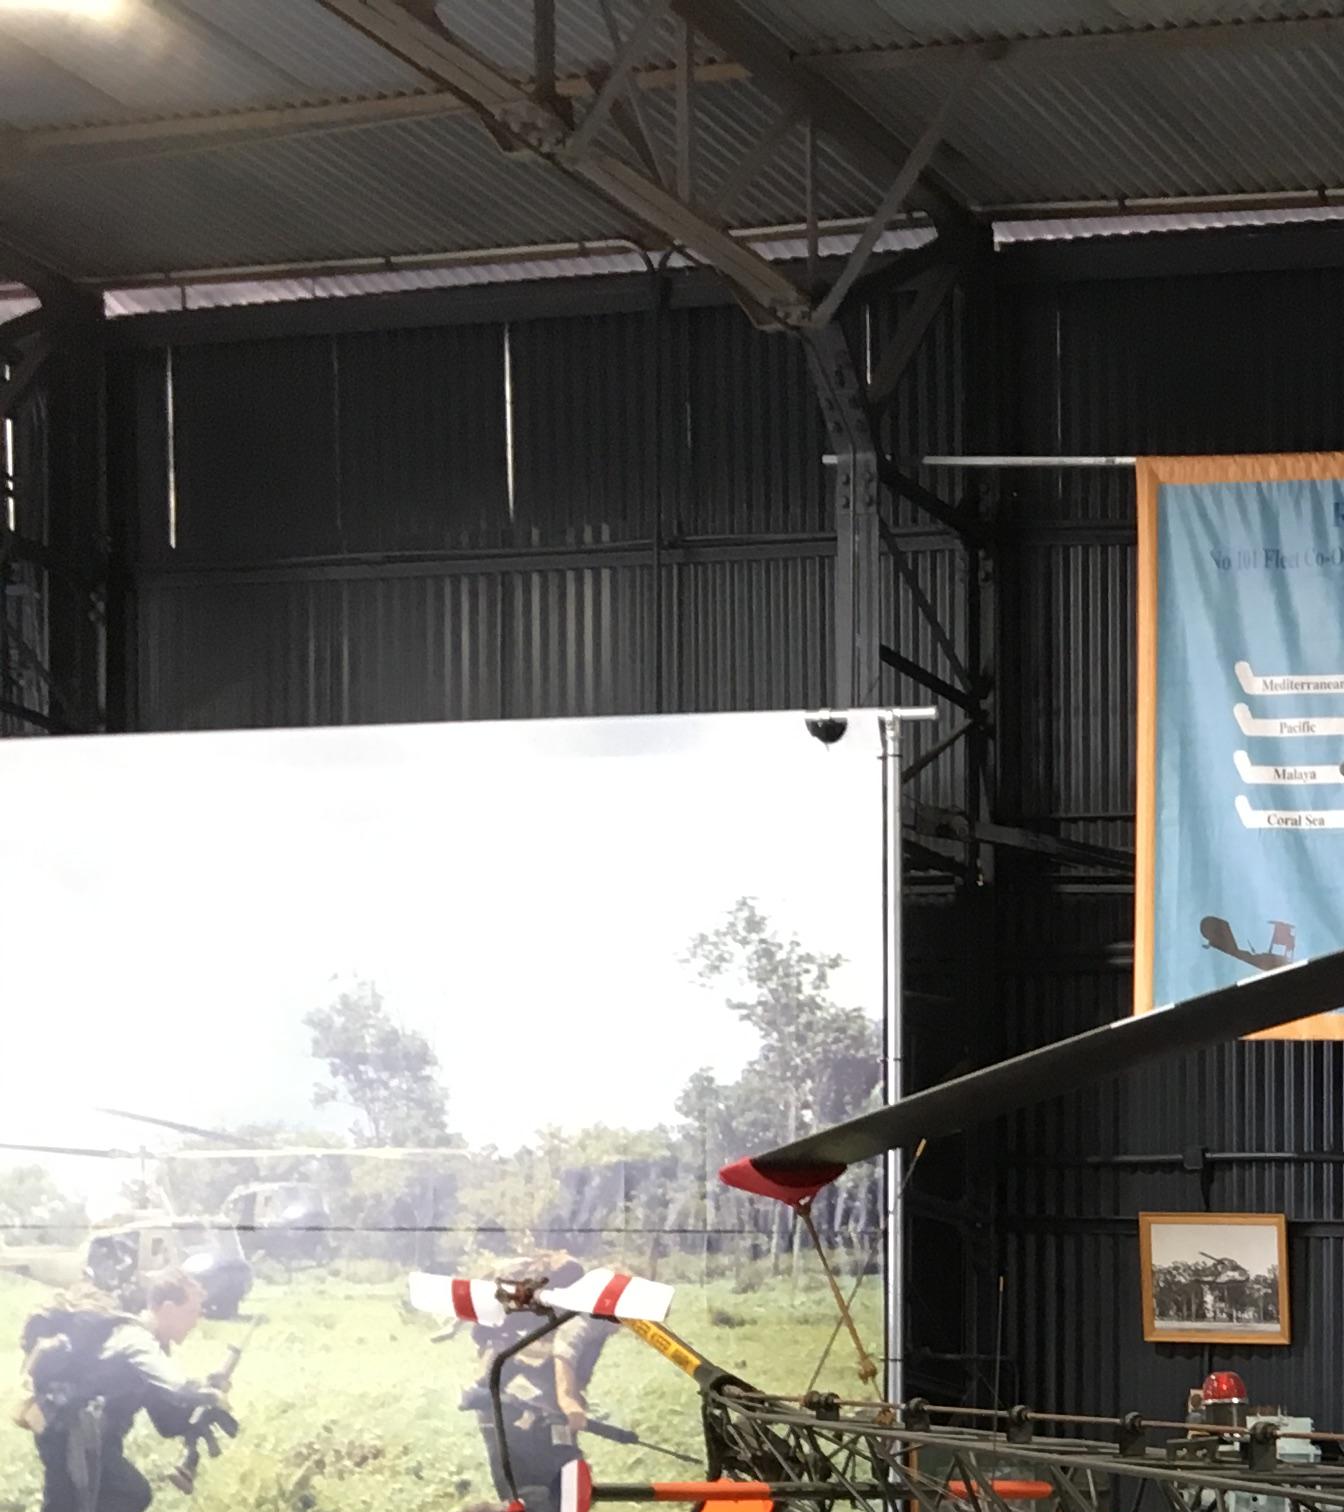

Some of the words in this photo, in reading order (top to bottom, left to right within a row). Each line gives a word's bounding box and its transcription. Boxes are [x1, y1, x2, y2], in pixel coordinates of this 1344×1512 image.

[1279, 721, 1316, 735] Pacific
[1273, 767, 1317, 783] Malaya
[1267, 813, 1302, 827] Coral
[1305, 814, 1325, 827] Sea
